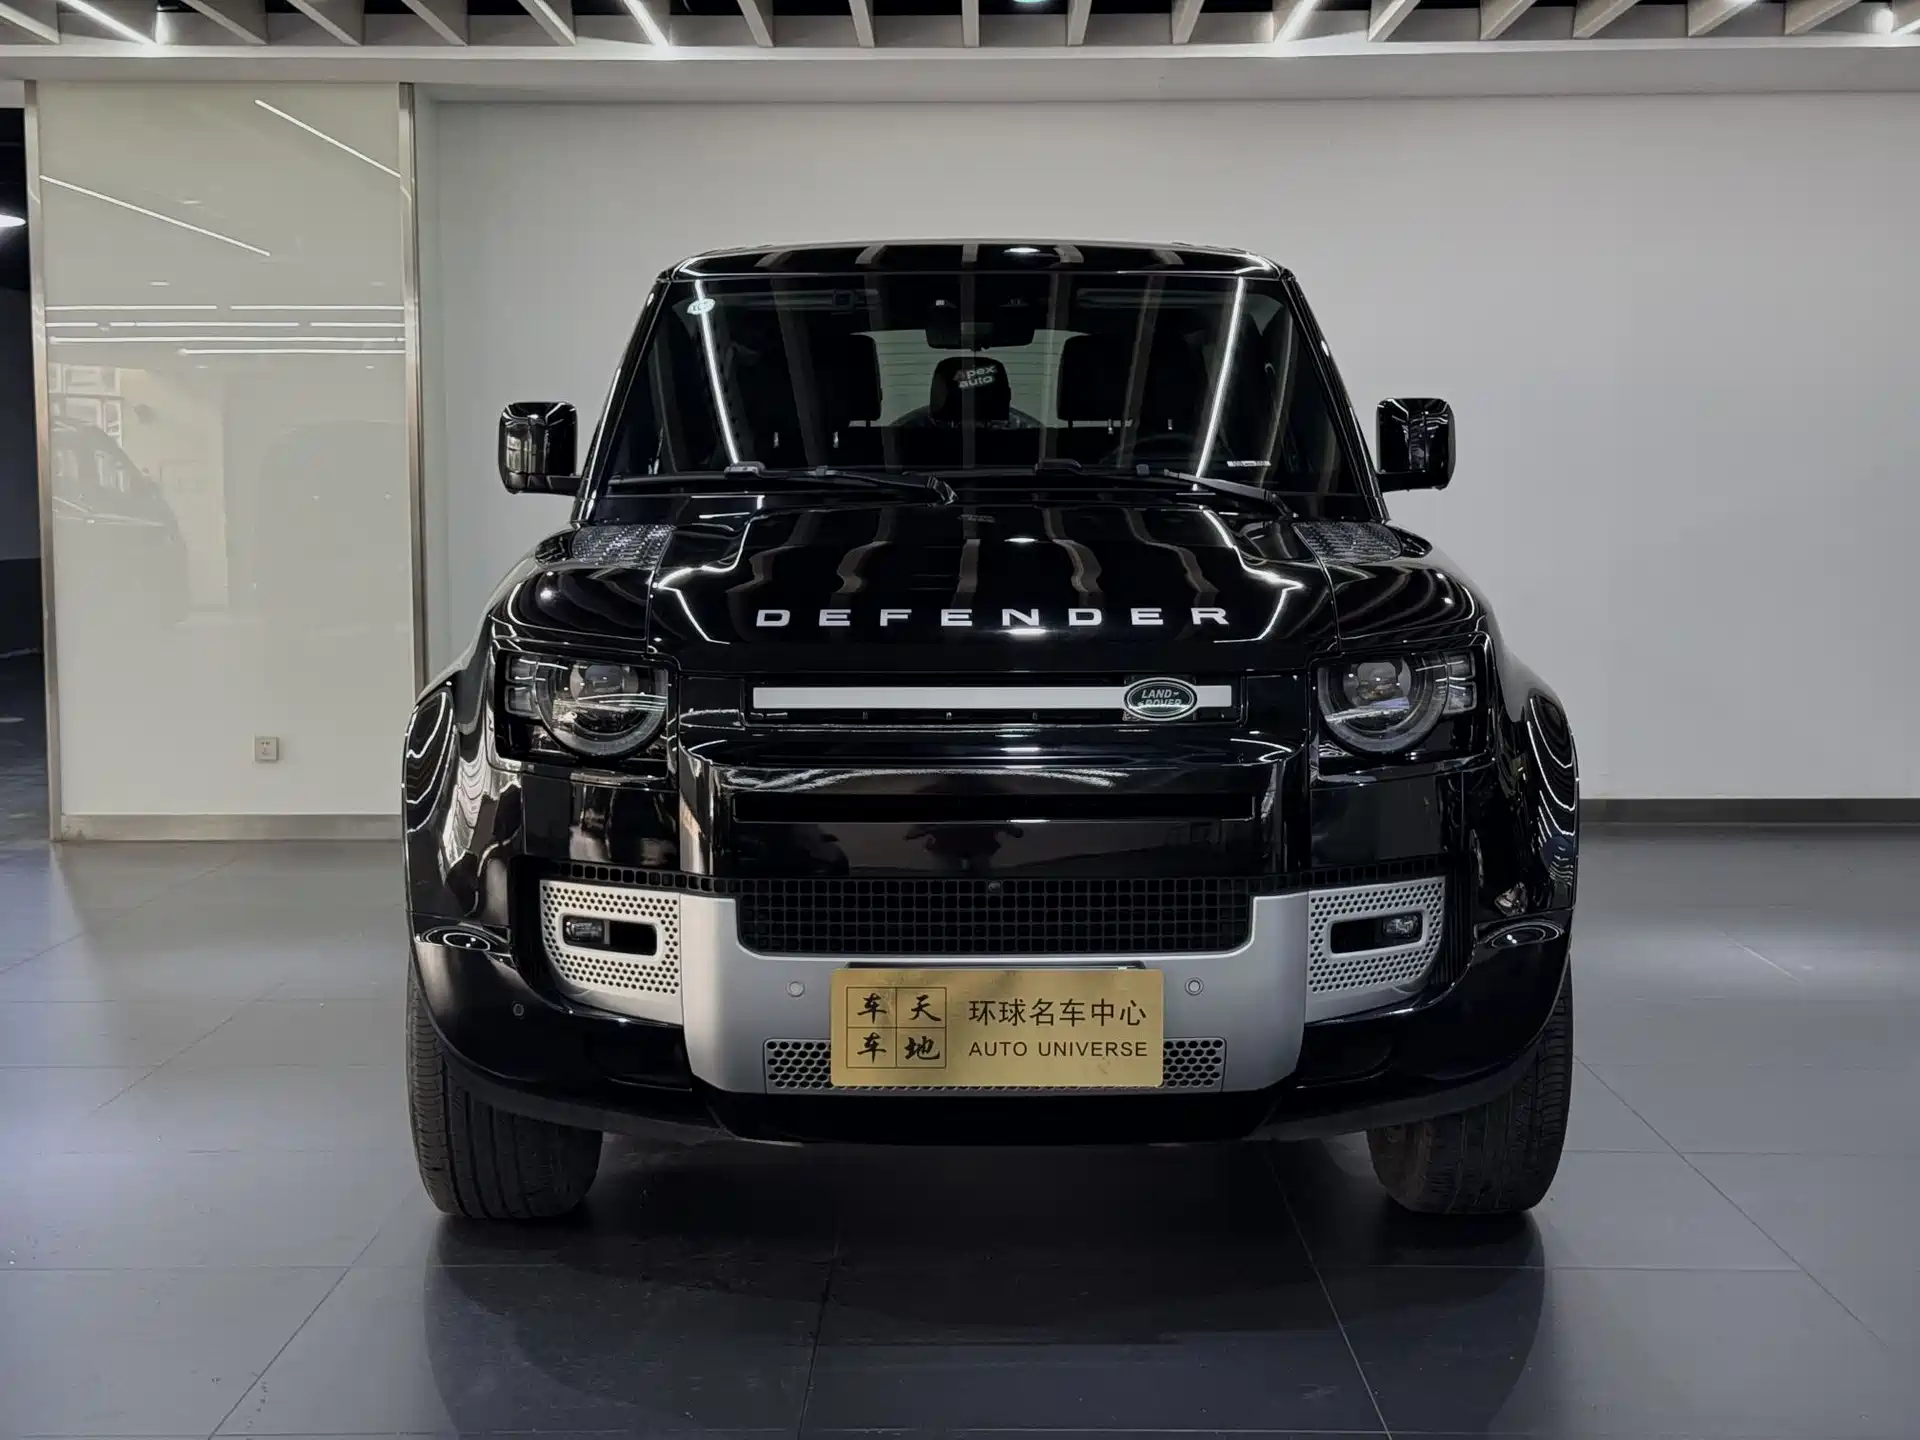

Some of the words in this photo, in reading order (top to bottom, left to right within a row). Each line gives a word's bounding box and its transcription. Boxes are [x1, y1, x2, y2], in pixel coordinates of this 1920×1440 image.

[959, 375, 993, 388] auto
[756, 607, 1229, 627] DEFENDER
[968, 998, 1147, 1027] 环球名车中心
[968, 1041, 1028, 1057] AUTO
[1038, 1041, 1148, 1057] UNIVERSE
